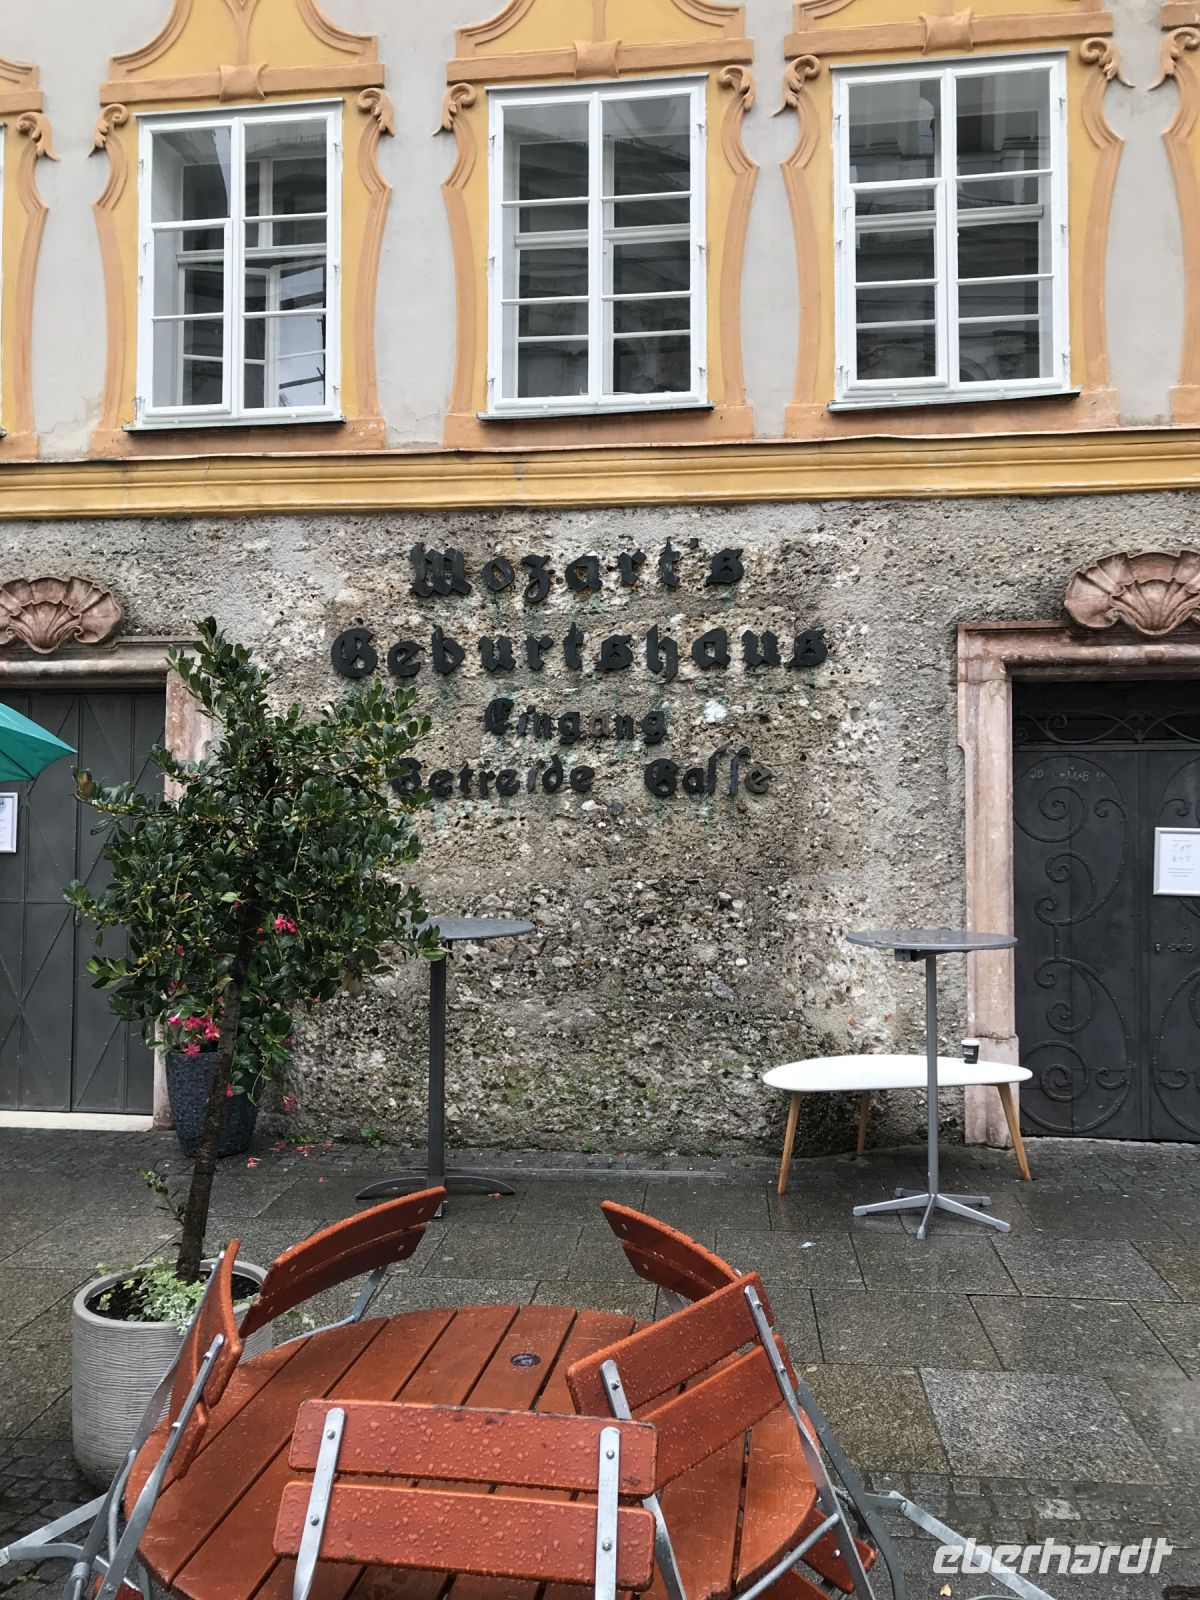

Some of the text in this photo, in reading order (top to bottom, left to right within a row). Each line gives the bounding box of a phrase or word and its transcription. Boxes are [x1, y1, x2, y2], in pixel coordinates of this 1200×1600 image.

[408, 536, 745, 600] Mozart's
[330, 621, 829, 683] Geburtshaus
[484, 697, 667, 744] Eingang
